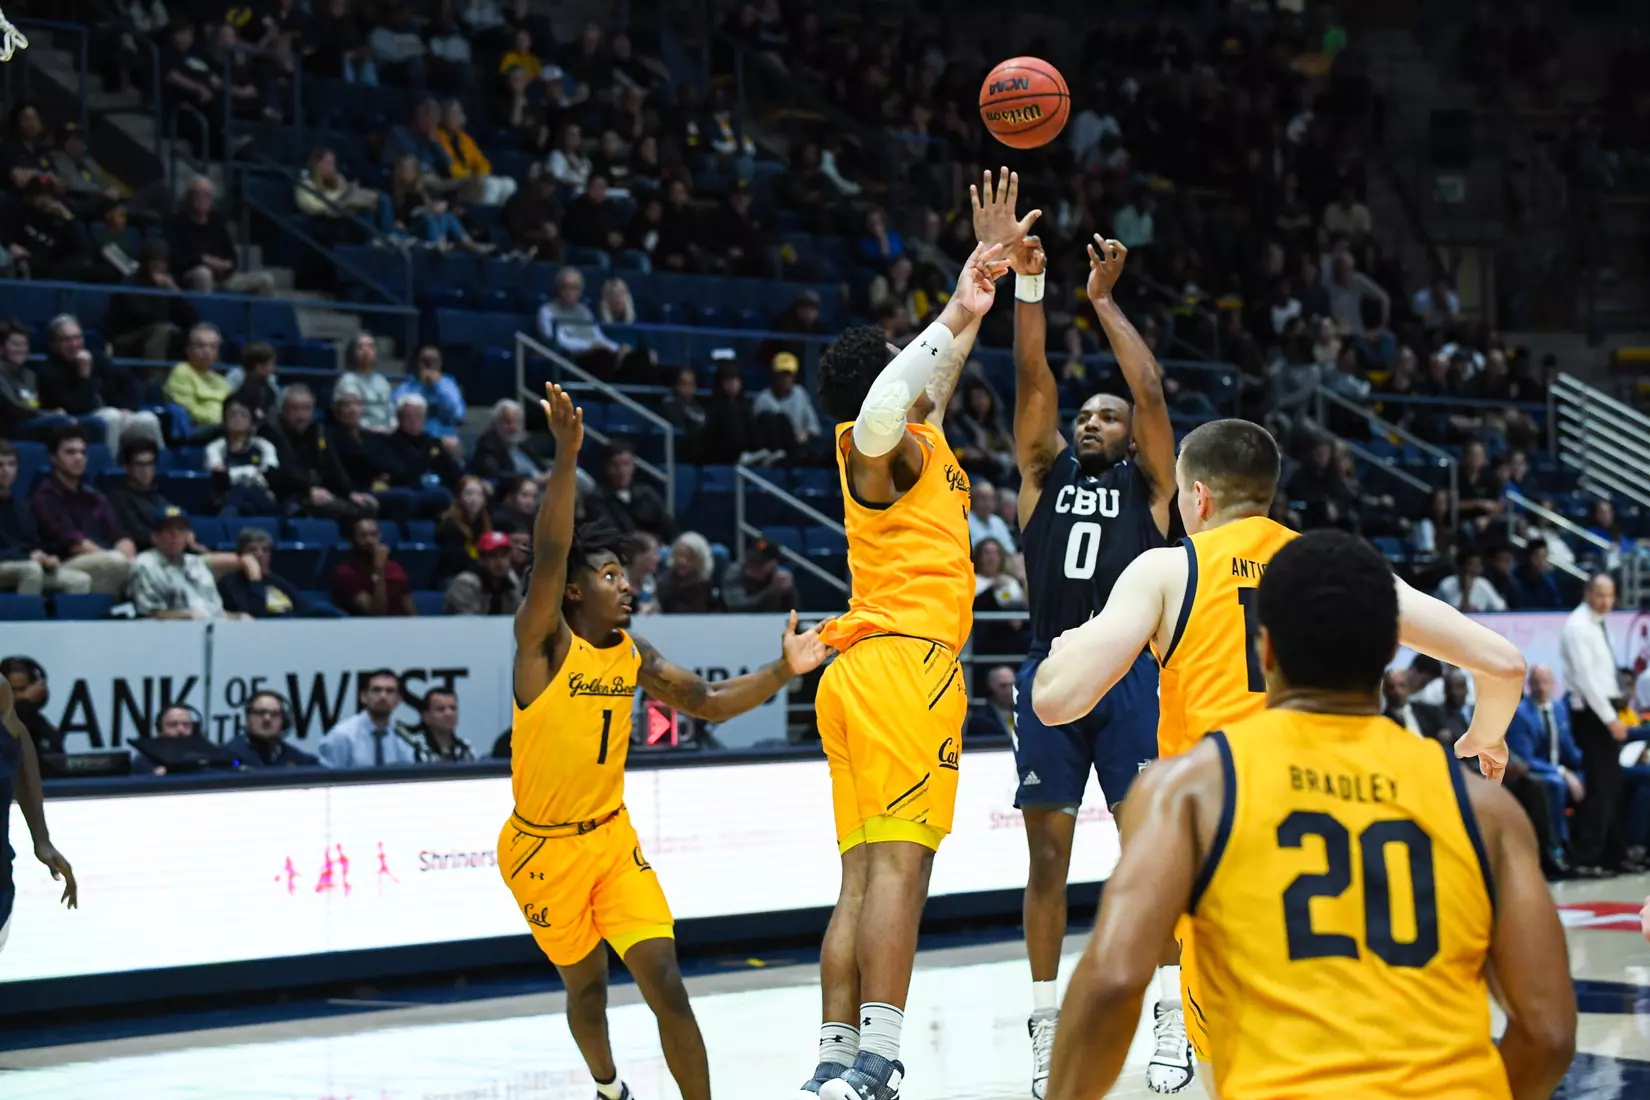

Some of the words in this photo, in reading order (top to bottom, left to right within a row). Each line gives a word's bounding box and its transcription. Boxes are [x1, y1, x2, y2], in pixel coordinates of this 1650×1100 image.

[986, 103, 1043, 124] Wilson
[1055, 485, 1120, 518] CBU
[1064, 522, 1101, 579] 0
[58, 675, 200, 748] ANK
[597, 709, 612, 764] 1
[1290, 764, 1397, 803] BRADLEY
[1277, 810, 1439, 967] 20
[524, 903, 551, 928] Cal
